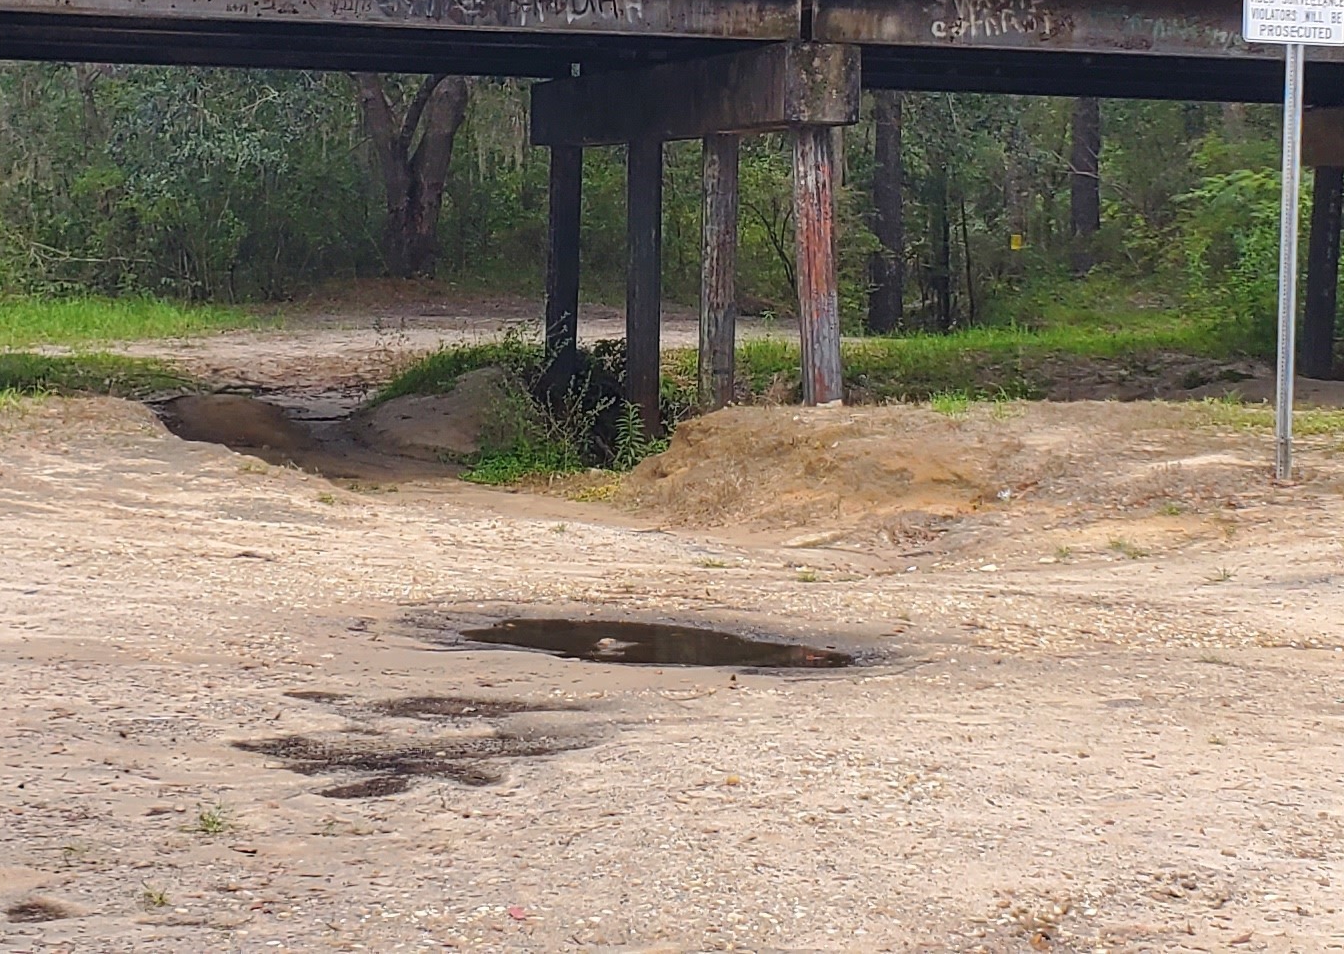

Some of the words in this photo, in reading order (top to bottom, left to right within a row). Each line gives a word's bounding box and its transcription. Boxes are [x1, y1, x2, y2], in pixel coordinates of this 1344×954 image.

[1251, 7, 1297, 22] VIOLATORS
[1304, 10, 1324, 23] WILL
[1331, 11, 1343, 24] BE
[1259, 24, 1332, 40] PROSECUTED
